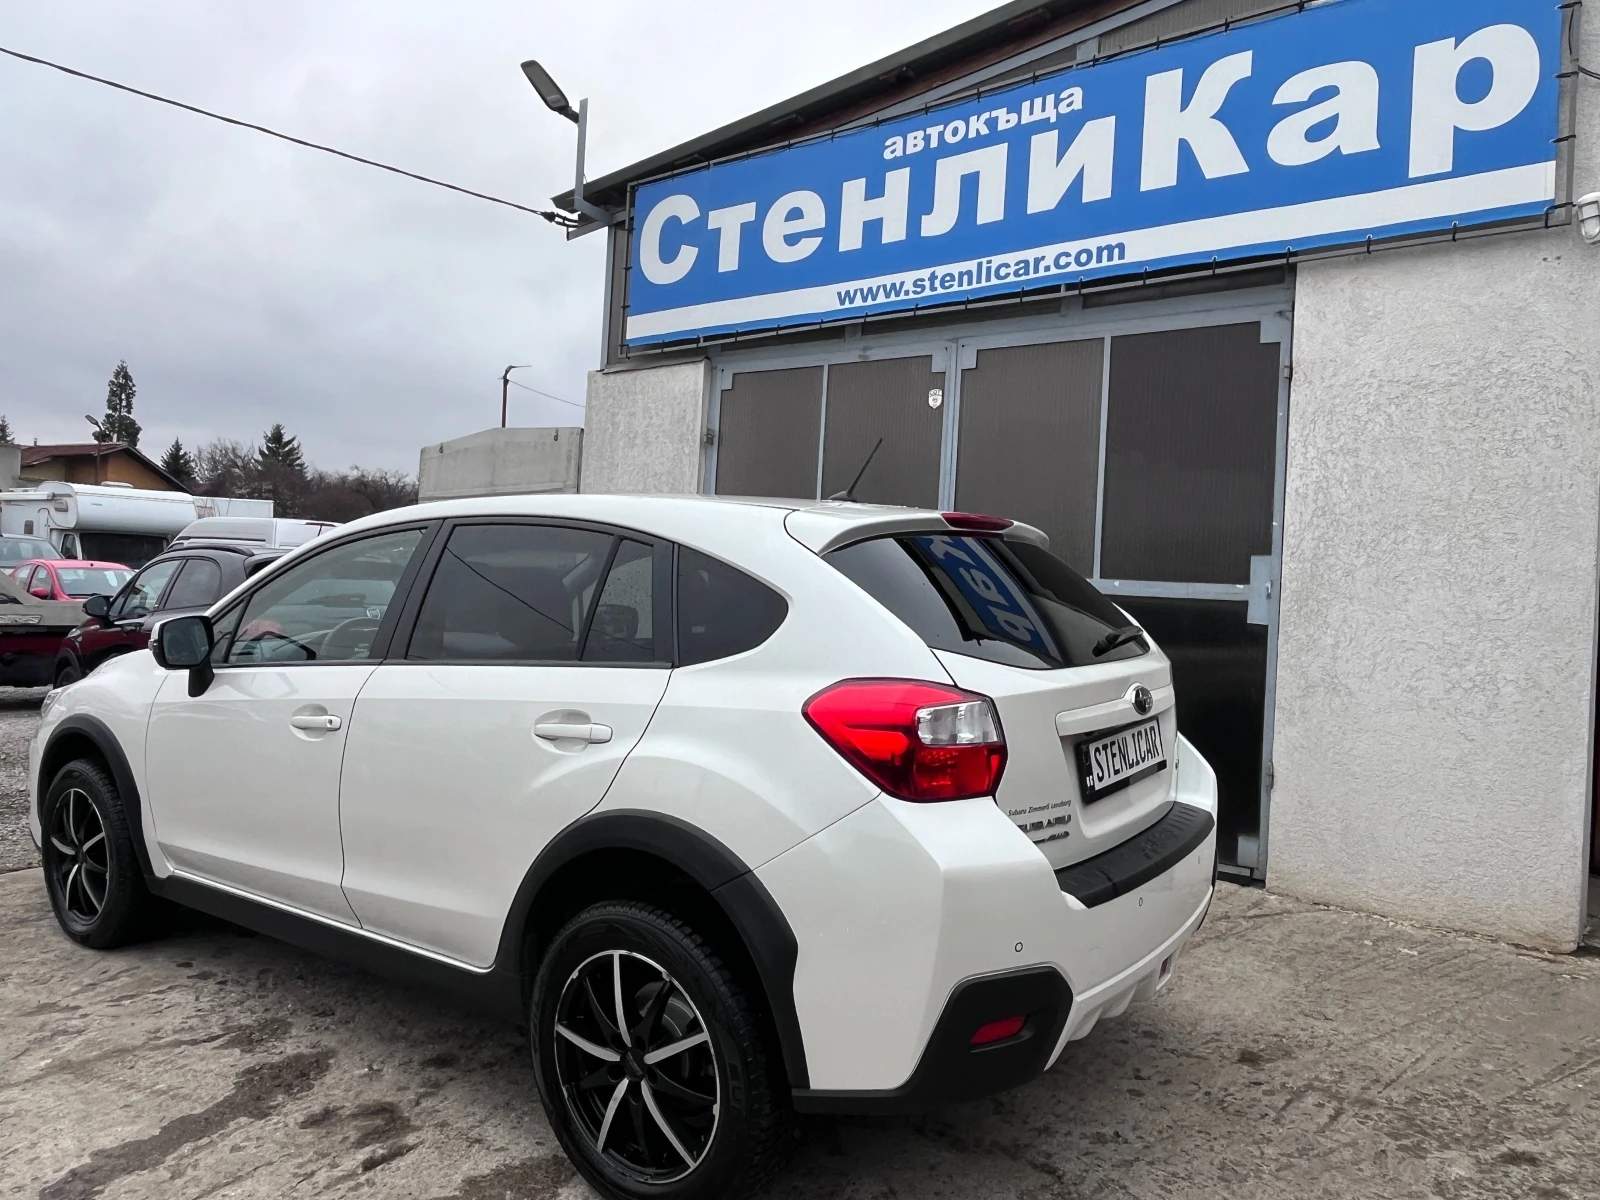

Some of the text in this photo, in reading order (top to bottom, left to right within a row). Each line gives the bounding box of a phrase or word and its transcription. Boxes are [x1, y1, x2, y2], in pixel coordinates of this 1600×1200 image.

[639, 22, 1541, 285] СтенлиКар
[882, 86, 1083, 160] автокъща
[836, 242, 1126, 306] www.stenlicar.com
[1093, 725, 1160, 783] STENLICAR
